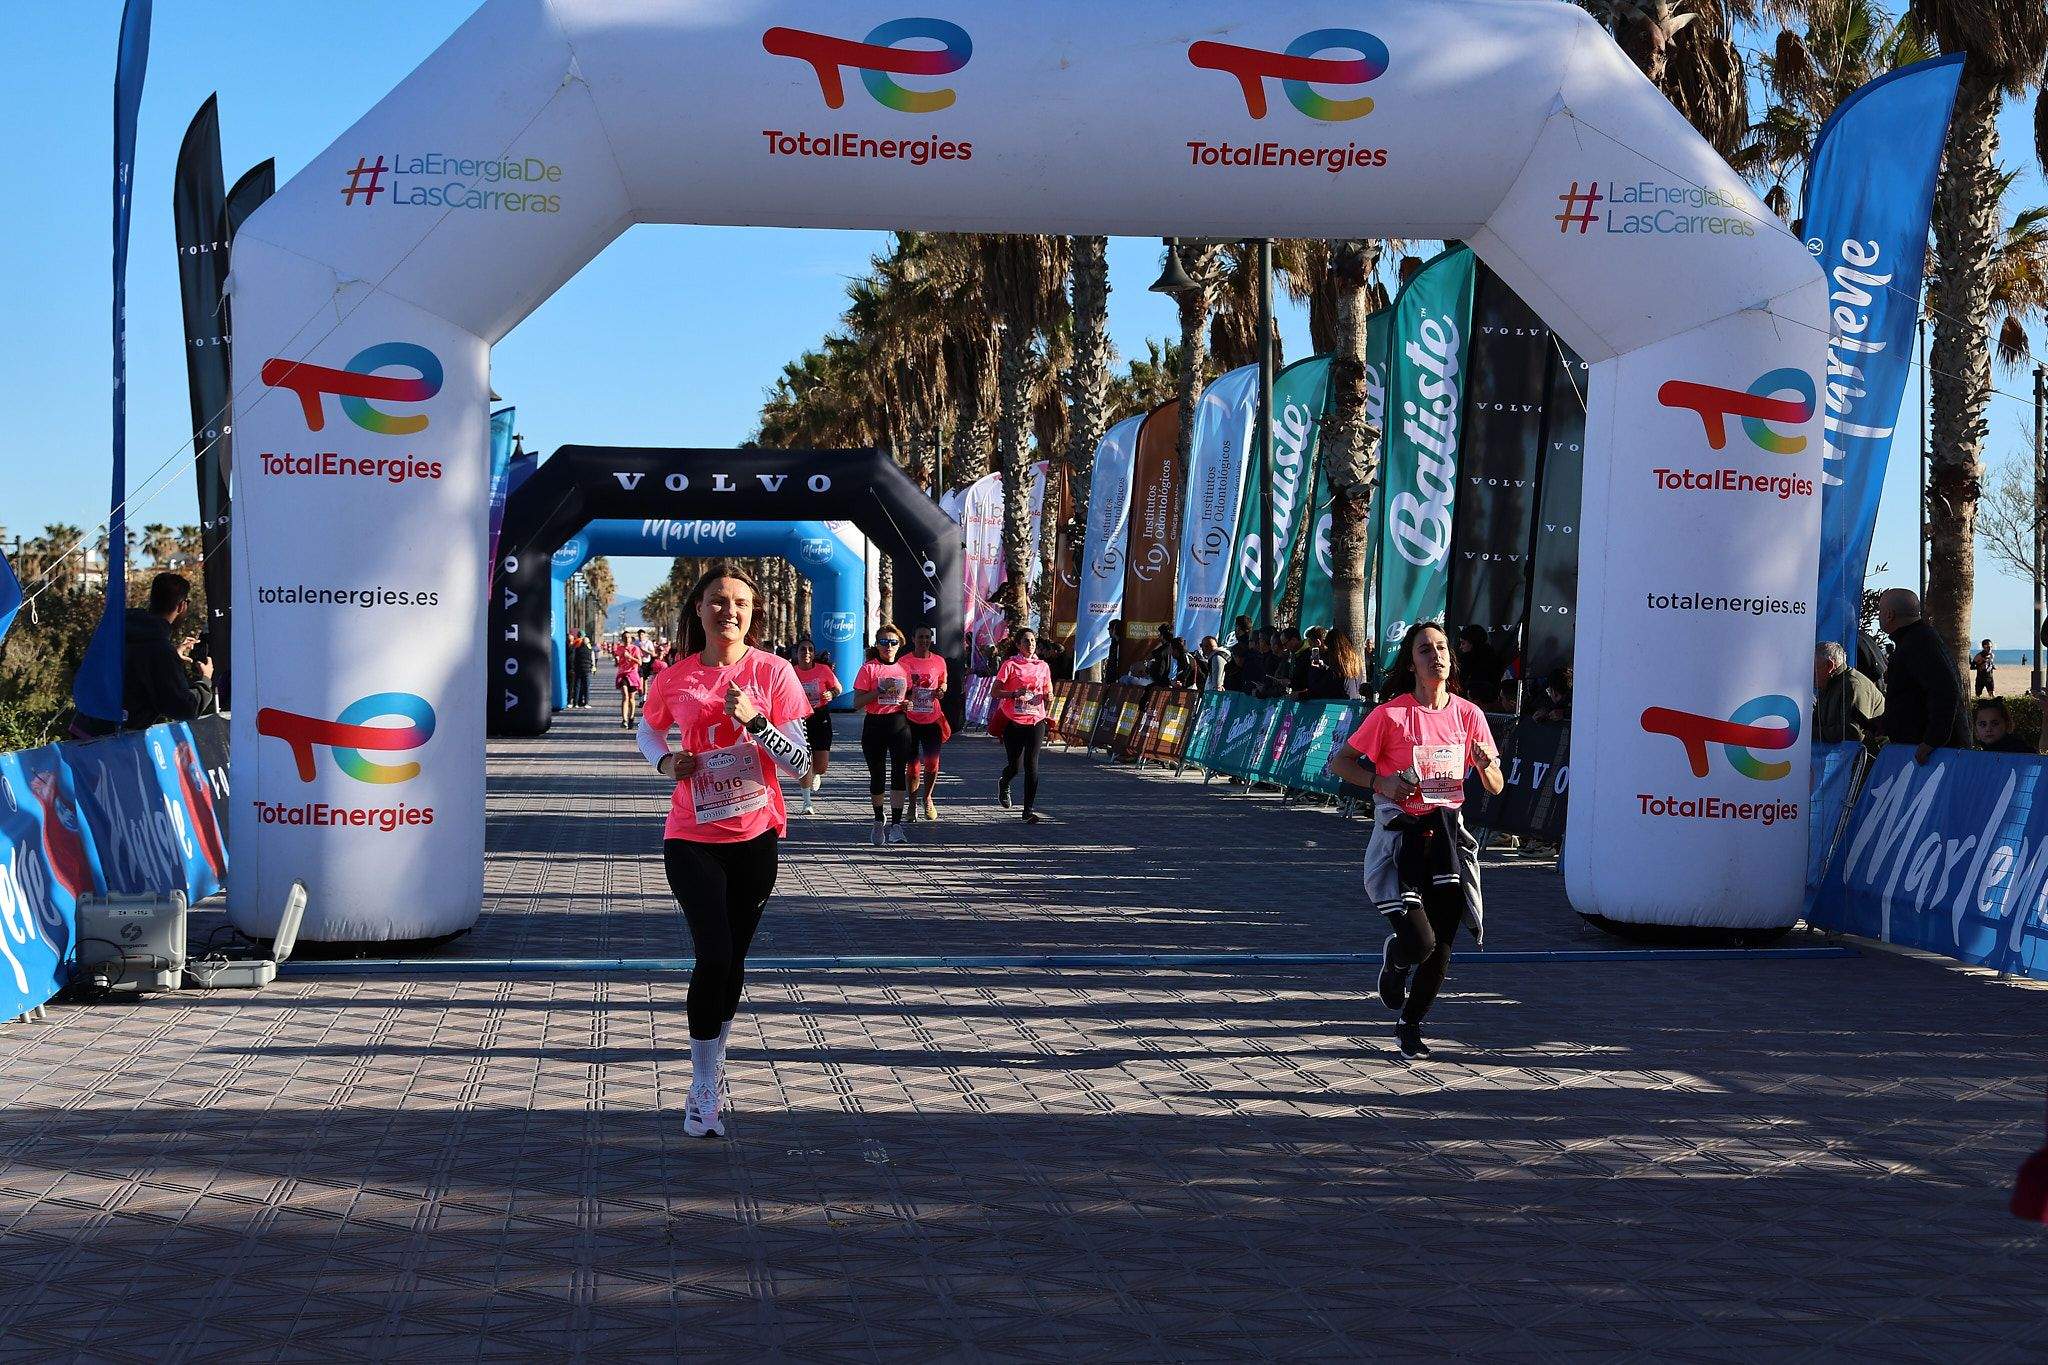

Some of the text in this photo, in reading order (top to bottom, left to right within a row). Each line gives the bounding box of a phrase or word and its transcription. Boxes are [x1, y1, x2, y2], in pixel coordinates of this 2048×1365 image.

[763, 130, 972, 165] TotalEnergies
[1187, 141, 1387, 172] TotalEnergies
[393, 180, 561, 213] LasCarreras
[1607, 209, 1755, 237] LasCarreras
[1390, 314, 1460, 571] Batiste
[261, 453, 442, 482] TotalEnergies
[612, 472, 832, 493] VOLVO
[1214, 439, 1231, 522] Odontológicos
[1155, 459, 1171, 539] Odontológicos
[1202, 466, 1216, 520] Institutos
[1653, 468, 1813, 500] TotalEnergies
[1142, 484, 1157, 539] Institutos
[641, 520, 737, 550] Marlene
[258, 585, 439, 608] totalenergies.es
[1646, 591, 1807, 616] totalenergies.es
[504, 555, 520, 712] VOLVO
[760, 729, 792, 758] KEEP
[714, 776, 743, 793] 016
[253, 801, 434, 832] TotalEnergies
[1637, 794, 1798, 826] TotalEnergies
